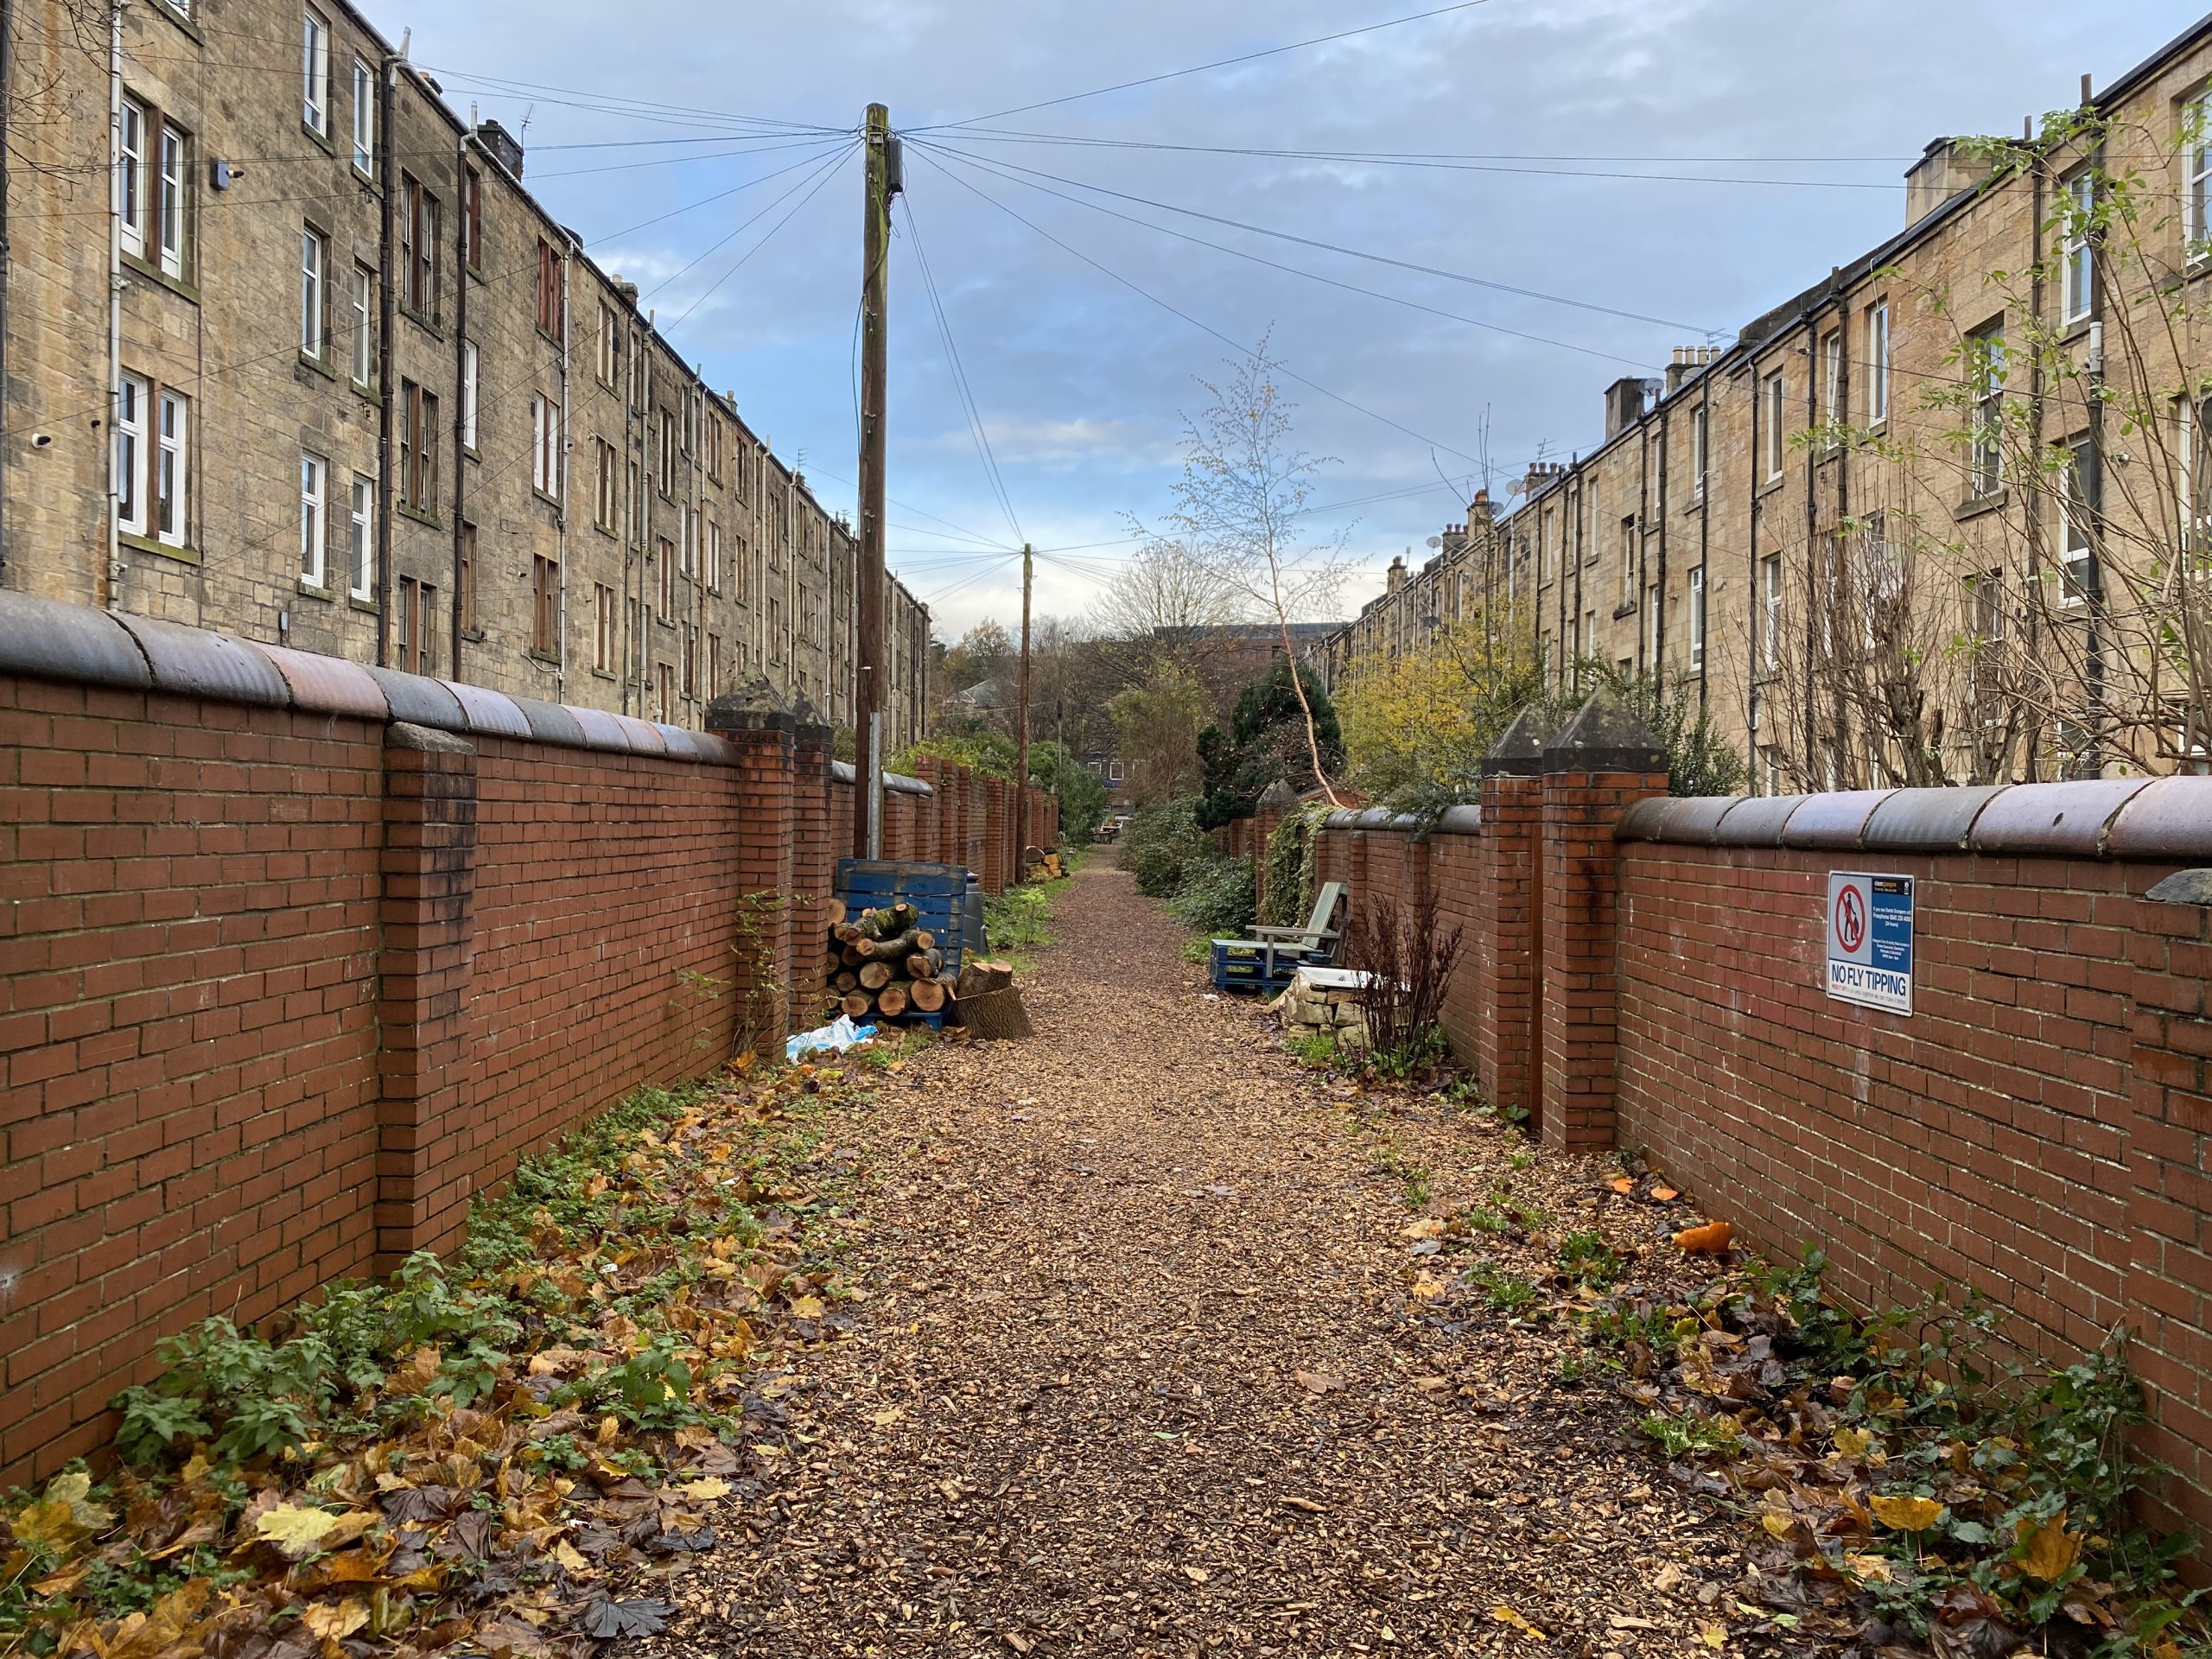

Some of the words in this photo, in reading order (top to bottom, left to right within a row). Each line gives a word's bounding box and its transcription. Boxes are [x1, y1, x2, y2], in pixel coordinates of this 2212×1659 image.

[1832, 964, 1846, 983] NO
[1848, 967, 1864, 987] FLY
[1866, 970, 1906, 996] TIPPING
